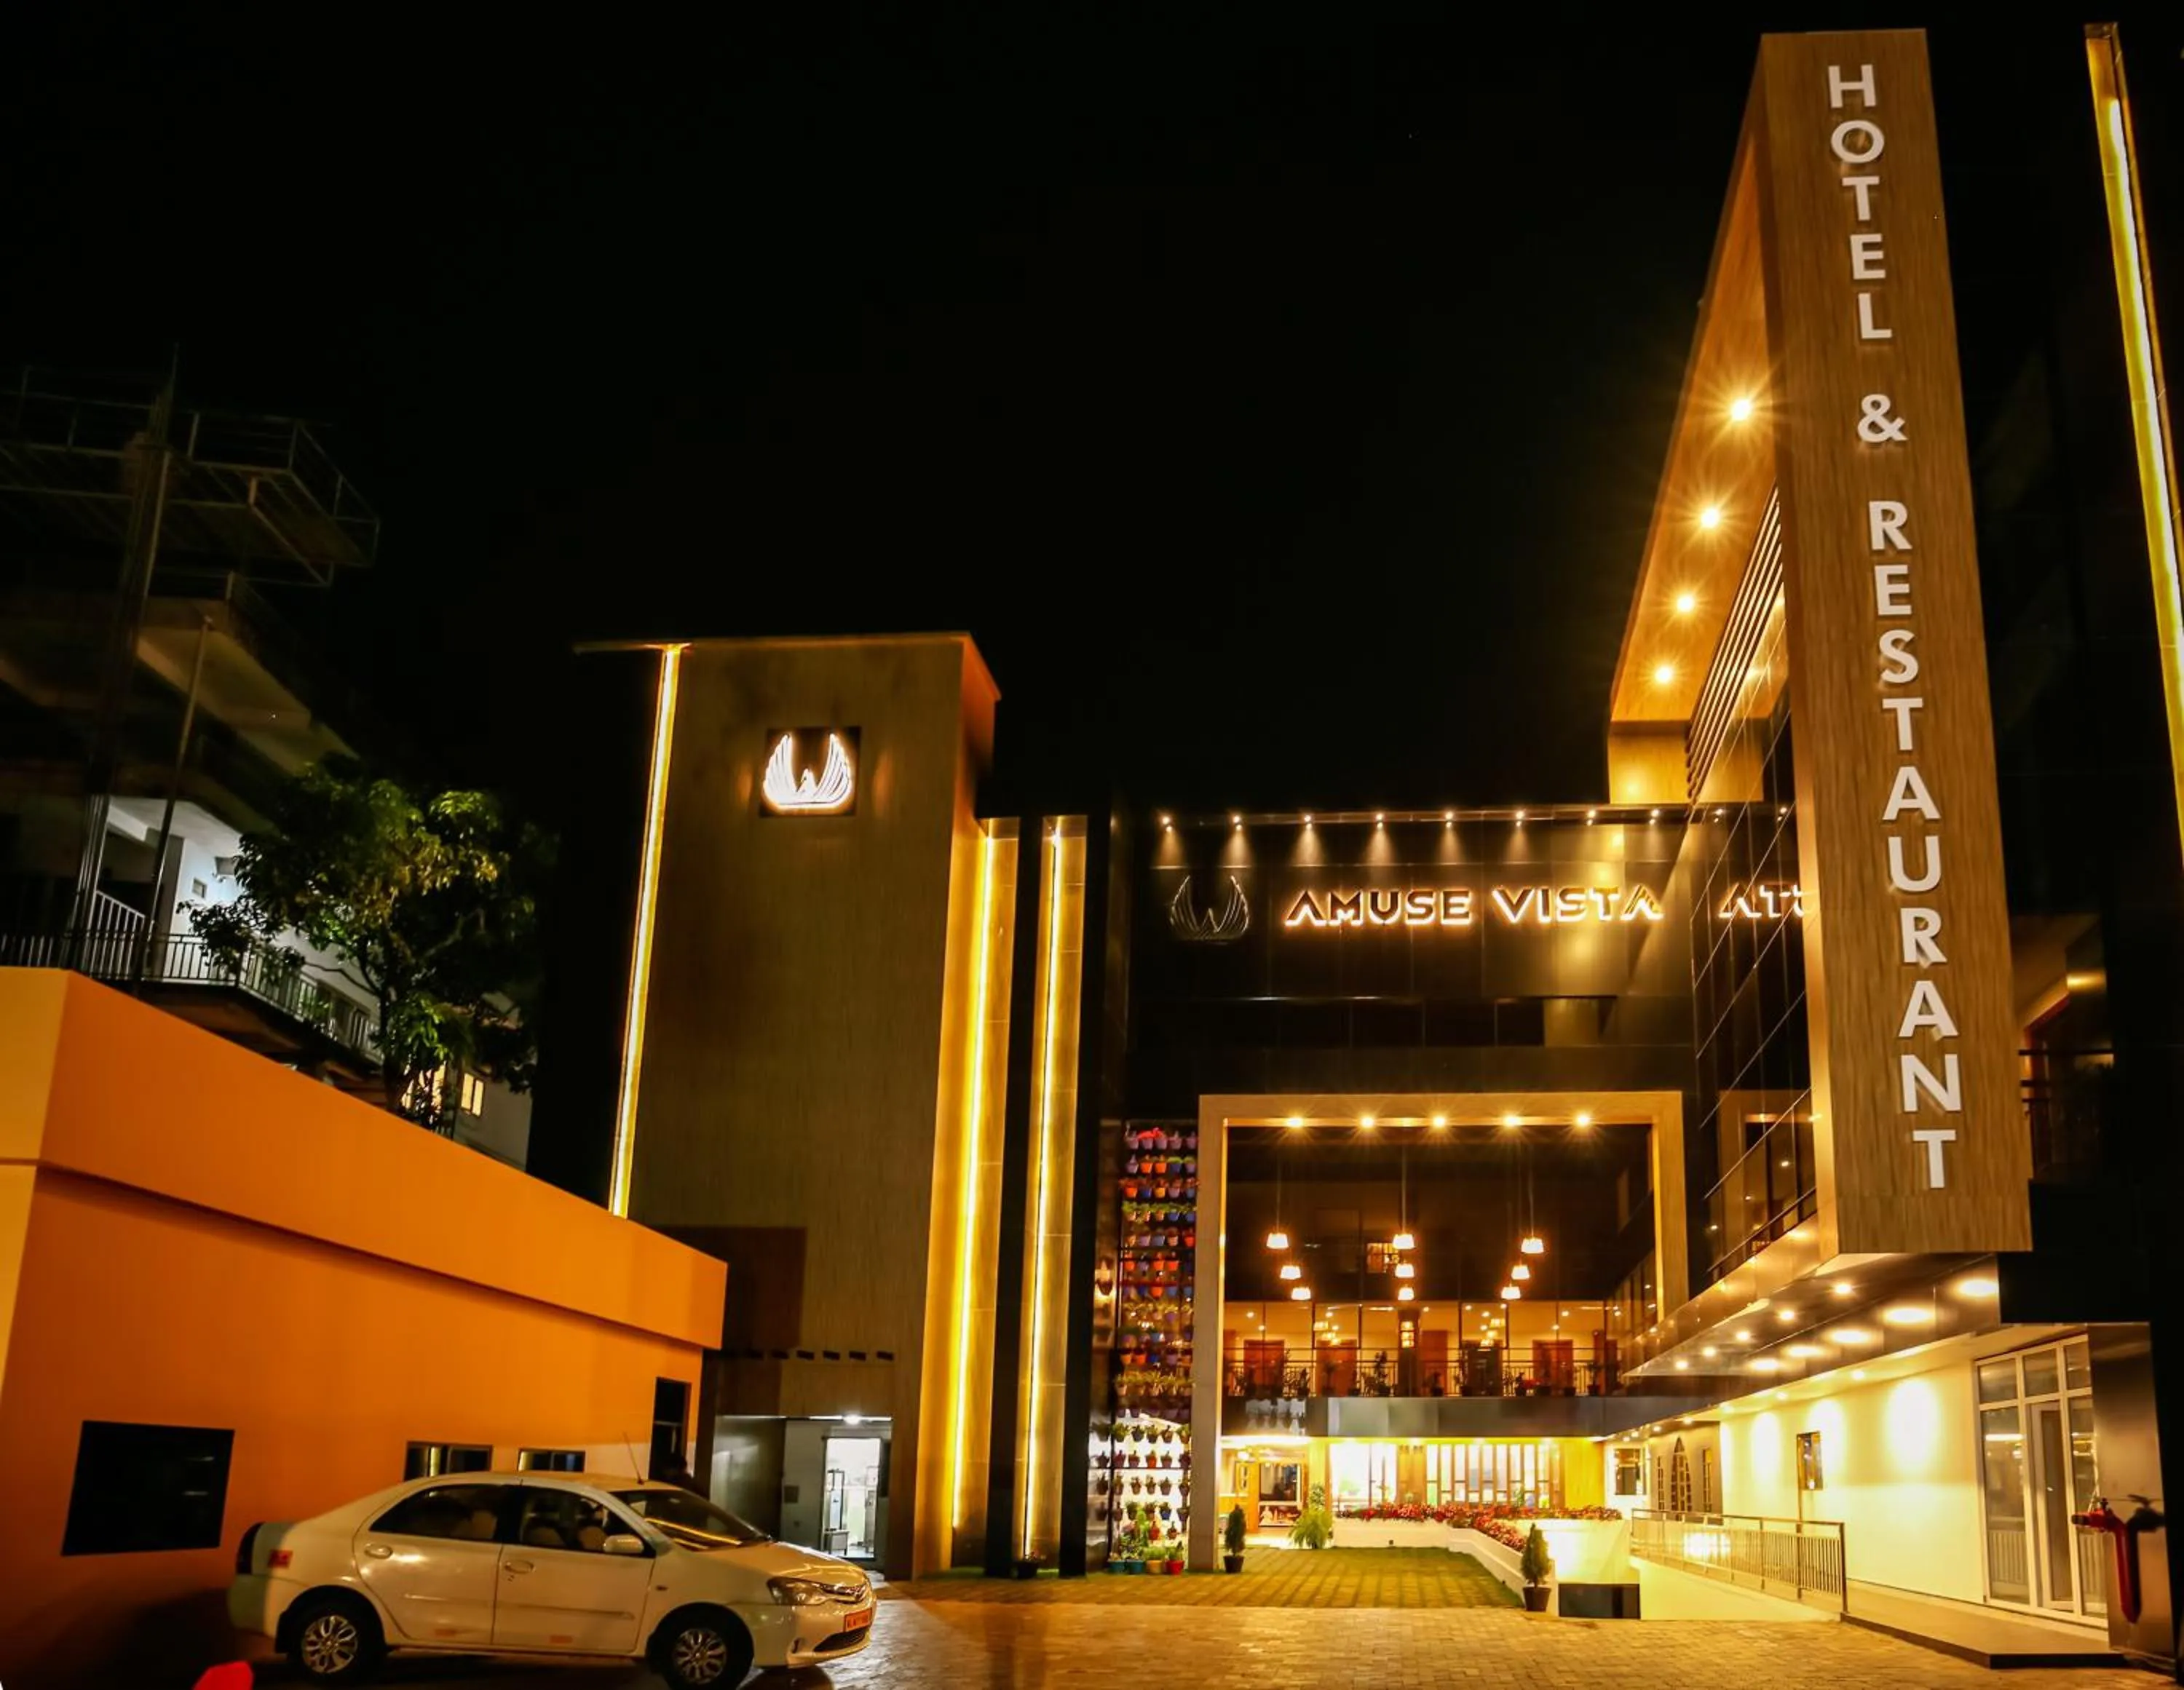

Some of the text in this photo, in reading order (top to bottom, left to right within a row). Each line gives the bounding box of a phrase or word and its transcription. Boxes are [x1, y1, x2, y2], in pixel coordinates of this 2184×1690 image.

[1284, 884, 1664, 927] AMUSE VISTA
[1827, 63, 1963, 1189] HOTEL & RESTAURANT
